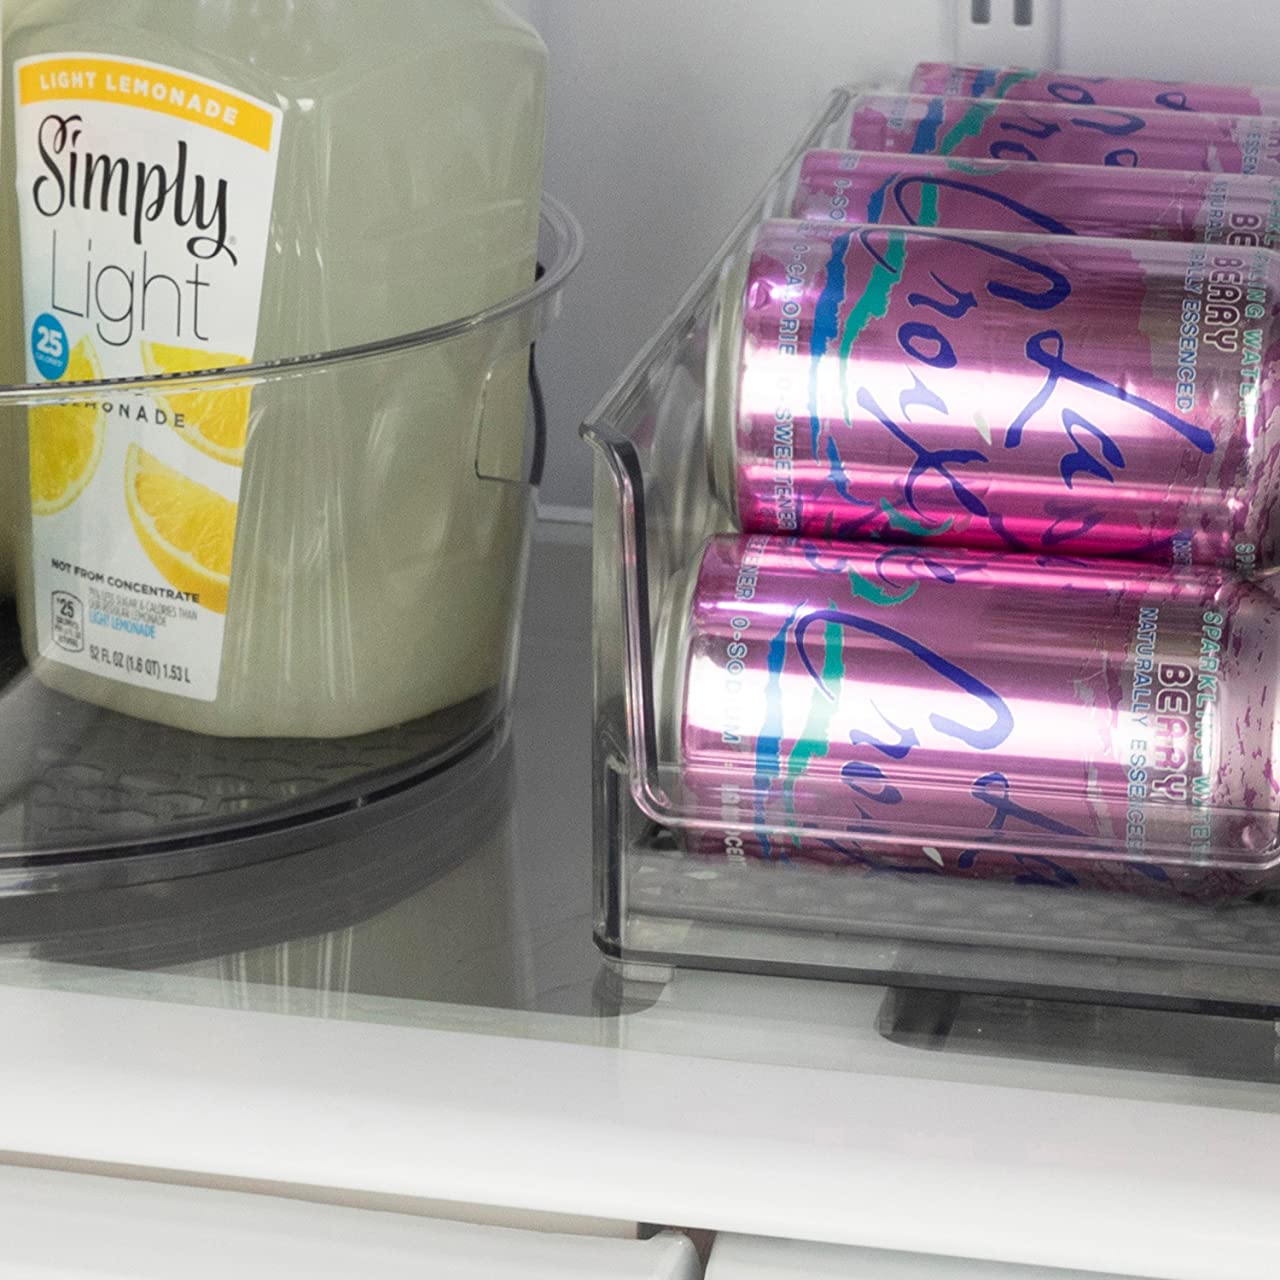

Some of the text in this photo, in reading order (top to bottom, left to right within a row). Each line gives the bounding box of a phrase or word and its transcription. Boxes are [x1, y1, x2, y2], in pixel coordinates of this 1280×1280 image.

[39, 71, 239, 127] LIGHT LEMONADE
[32, 114, 238, 267] Simply
[52, 229, 210, 346] Light
[1203, 256, 1245, 353] BERRY
[37, 325, 63, 358] 25
[1174, 299, 1200, 413] ESSENCED
[51, 558, 72, 572] NOT
[74, 566, 104, 583] FROM
[107, 576, 200, 603] CONCENTRATE
[184, 669, 191, 683] L
[1130, 607, 1160, 727] NATURALLY
[1150, 662, 1194, 800] BERRY
